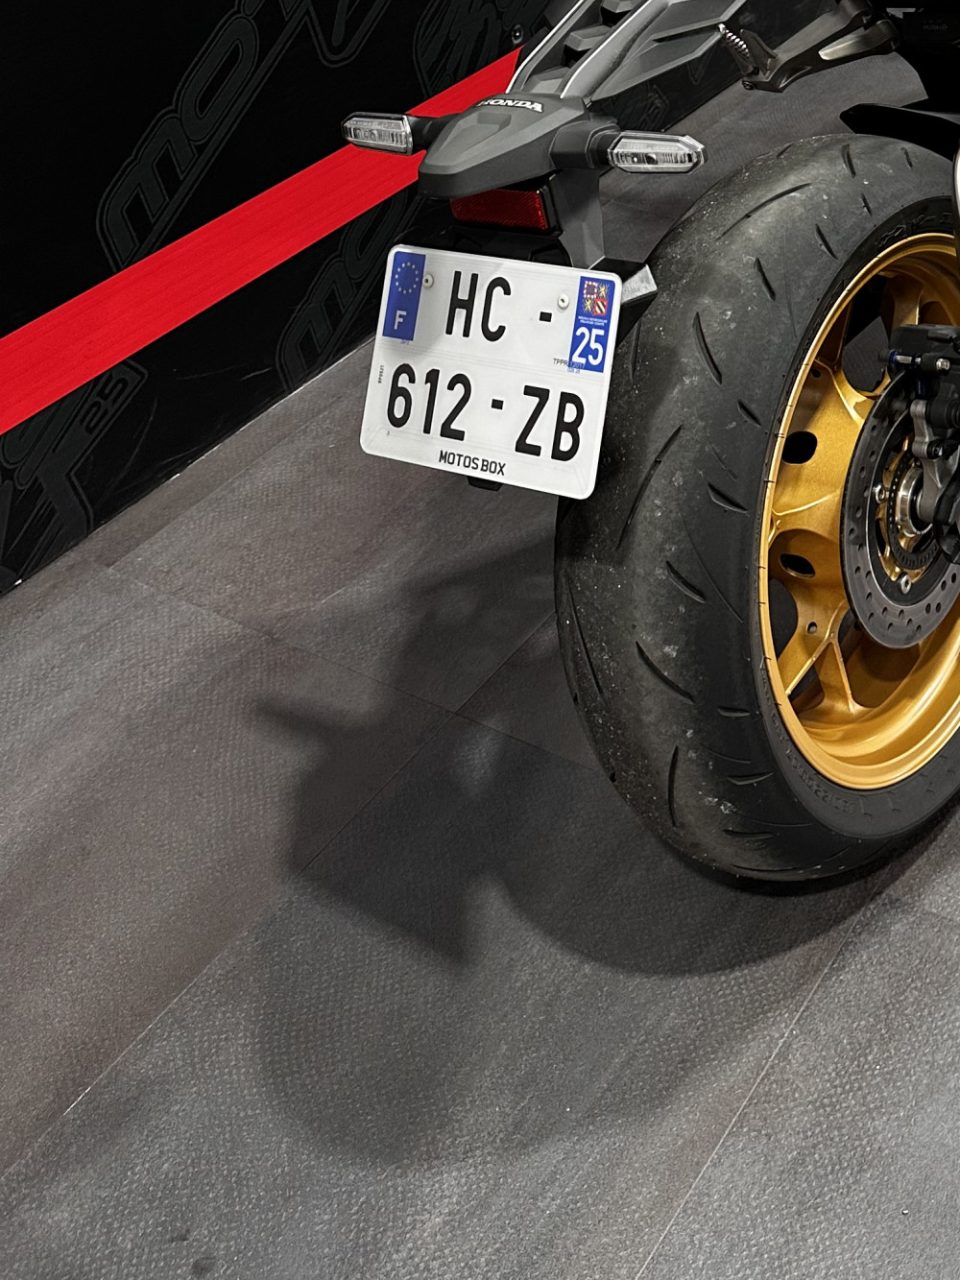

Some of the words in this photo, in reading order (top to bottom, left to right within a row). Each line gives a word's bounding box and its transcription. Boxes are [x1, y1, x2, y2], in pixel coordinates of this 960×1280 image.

[477, 98, 543, 113] HONDA
[394, 310, 407, 330] F
[571, 326, 605, 366] 25
